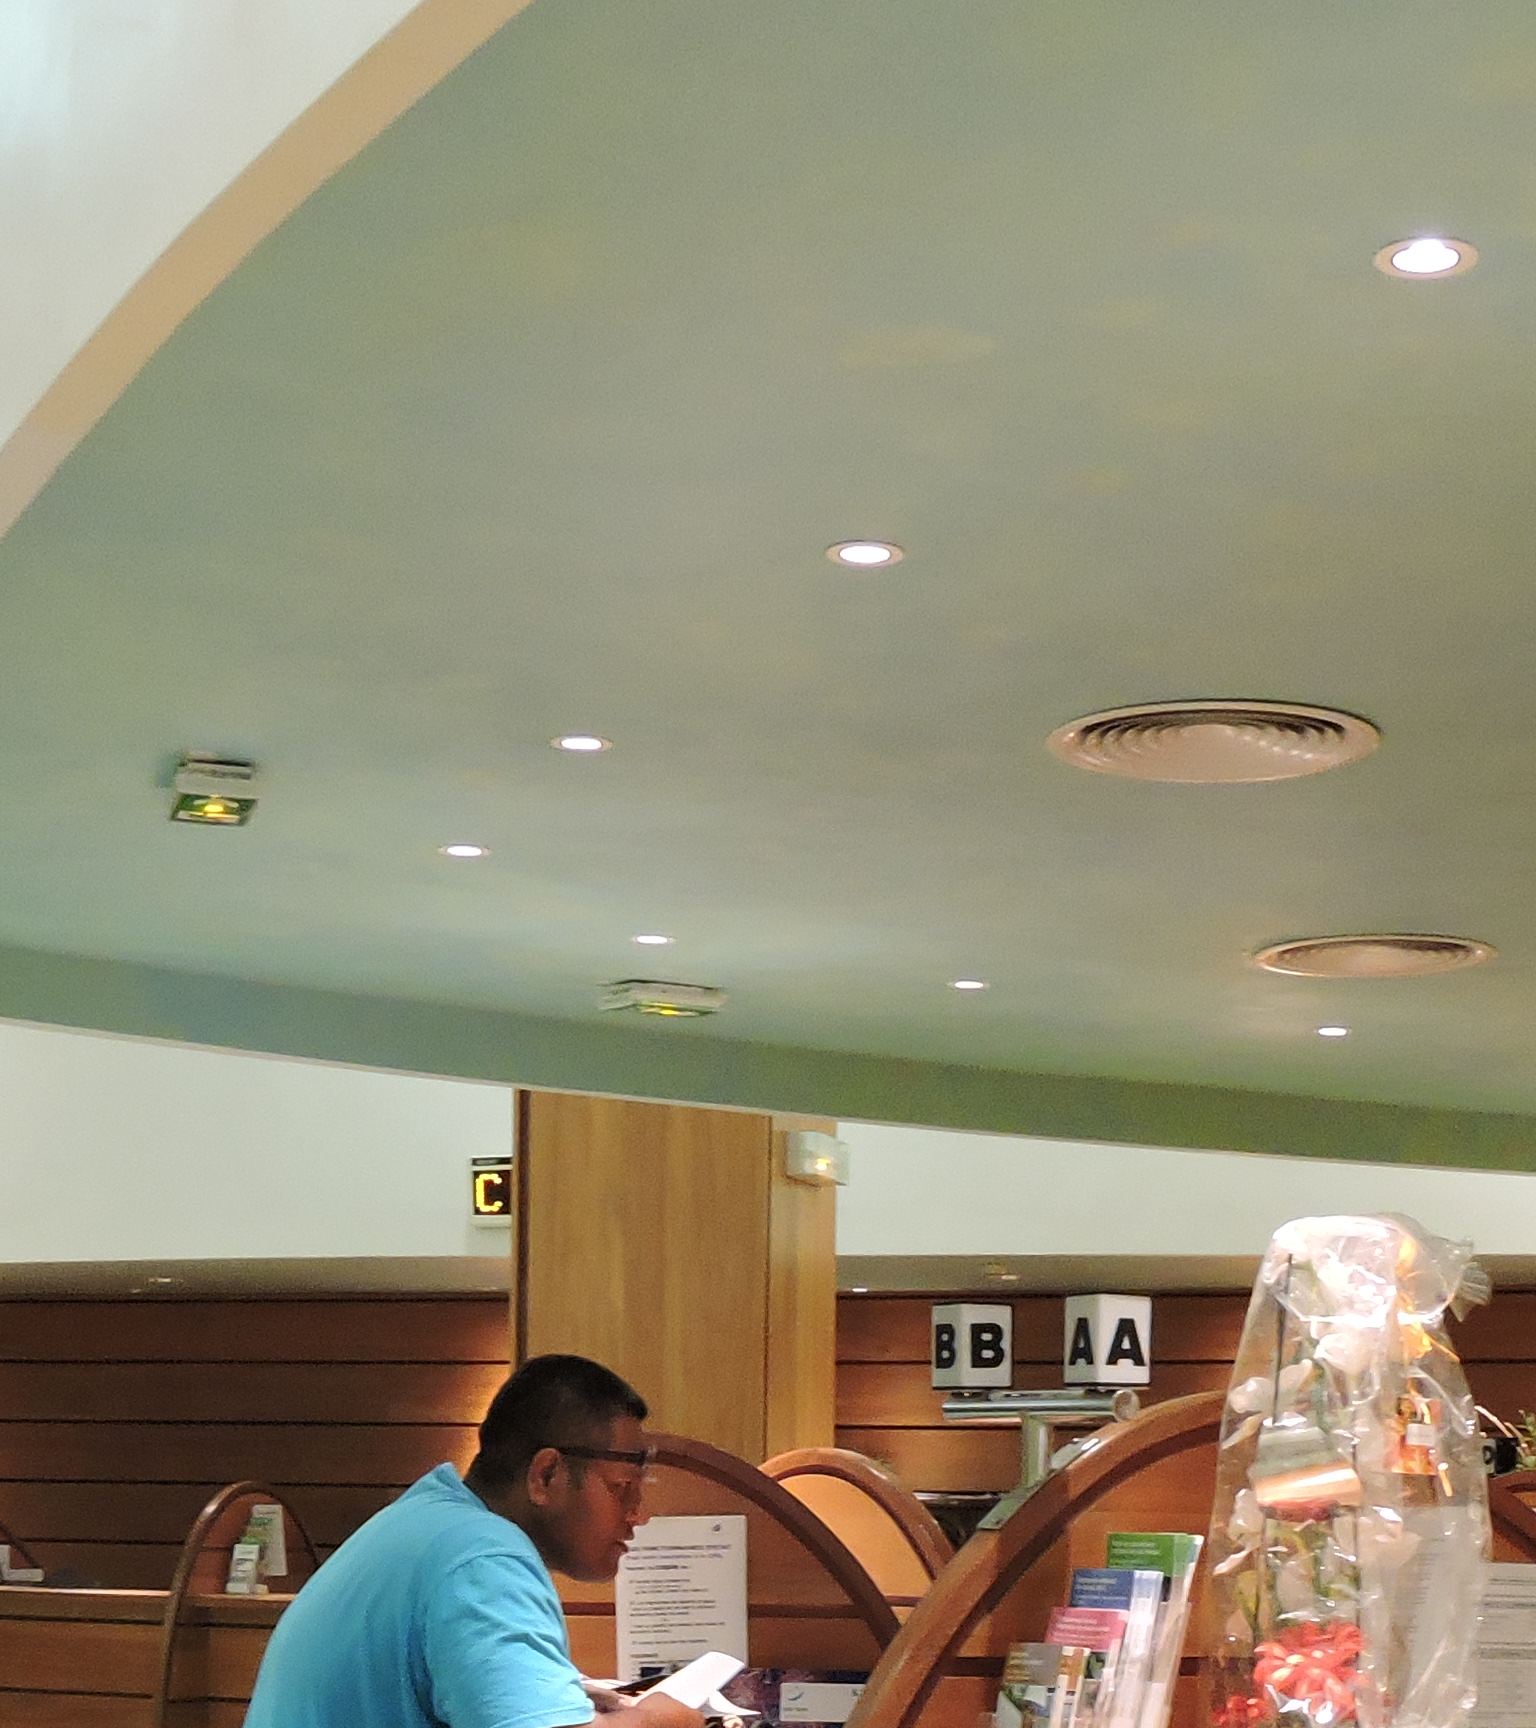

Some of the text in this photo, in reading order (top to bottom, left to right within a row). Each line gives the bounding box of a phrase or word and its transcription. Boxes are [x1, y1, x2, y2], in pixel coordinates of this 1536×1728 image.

[475, 1173, 503, 1212] C
[935, 1323, 956, 1369] B
[971, 1322, 1005, 1368] B
[1068, 1317, 1094, 1365] A
[1105, 1318, 1147, 1366] A
